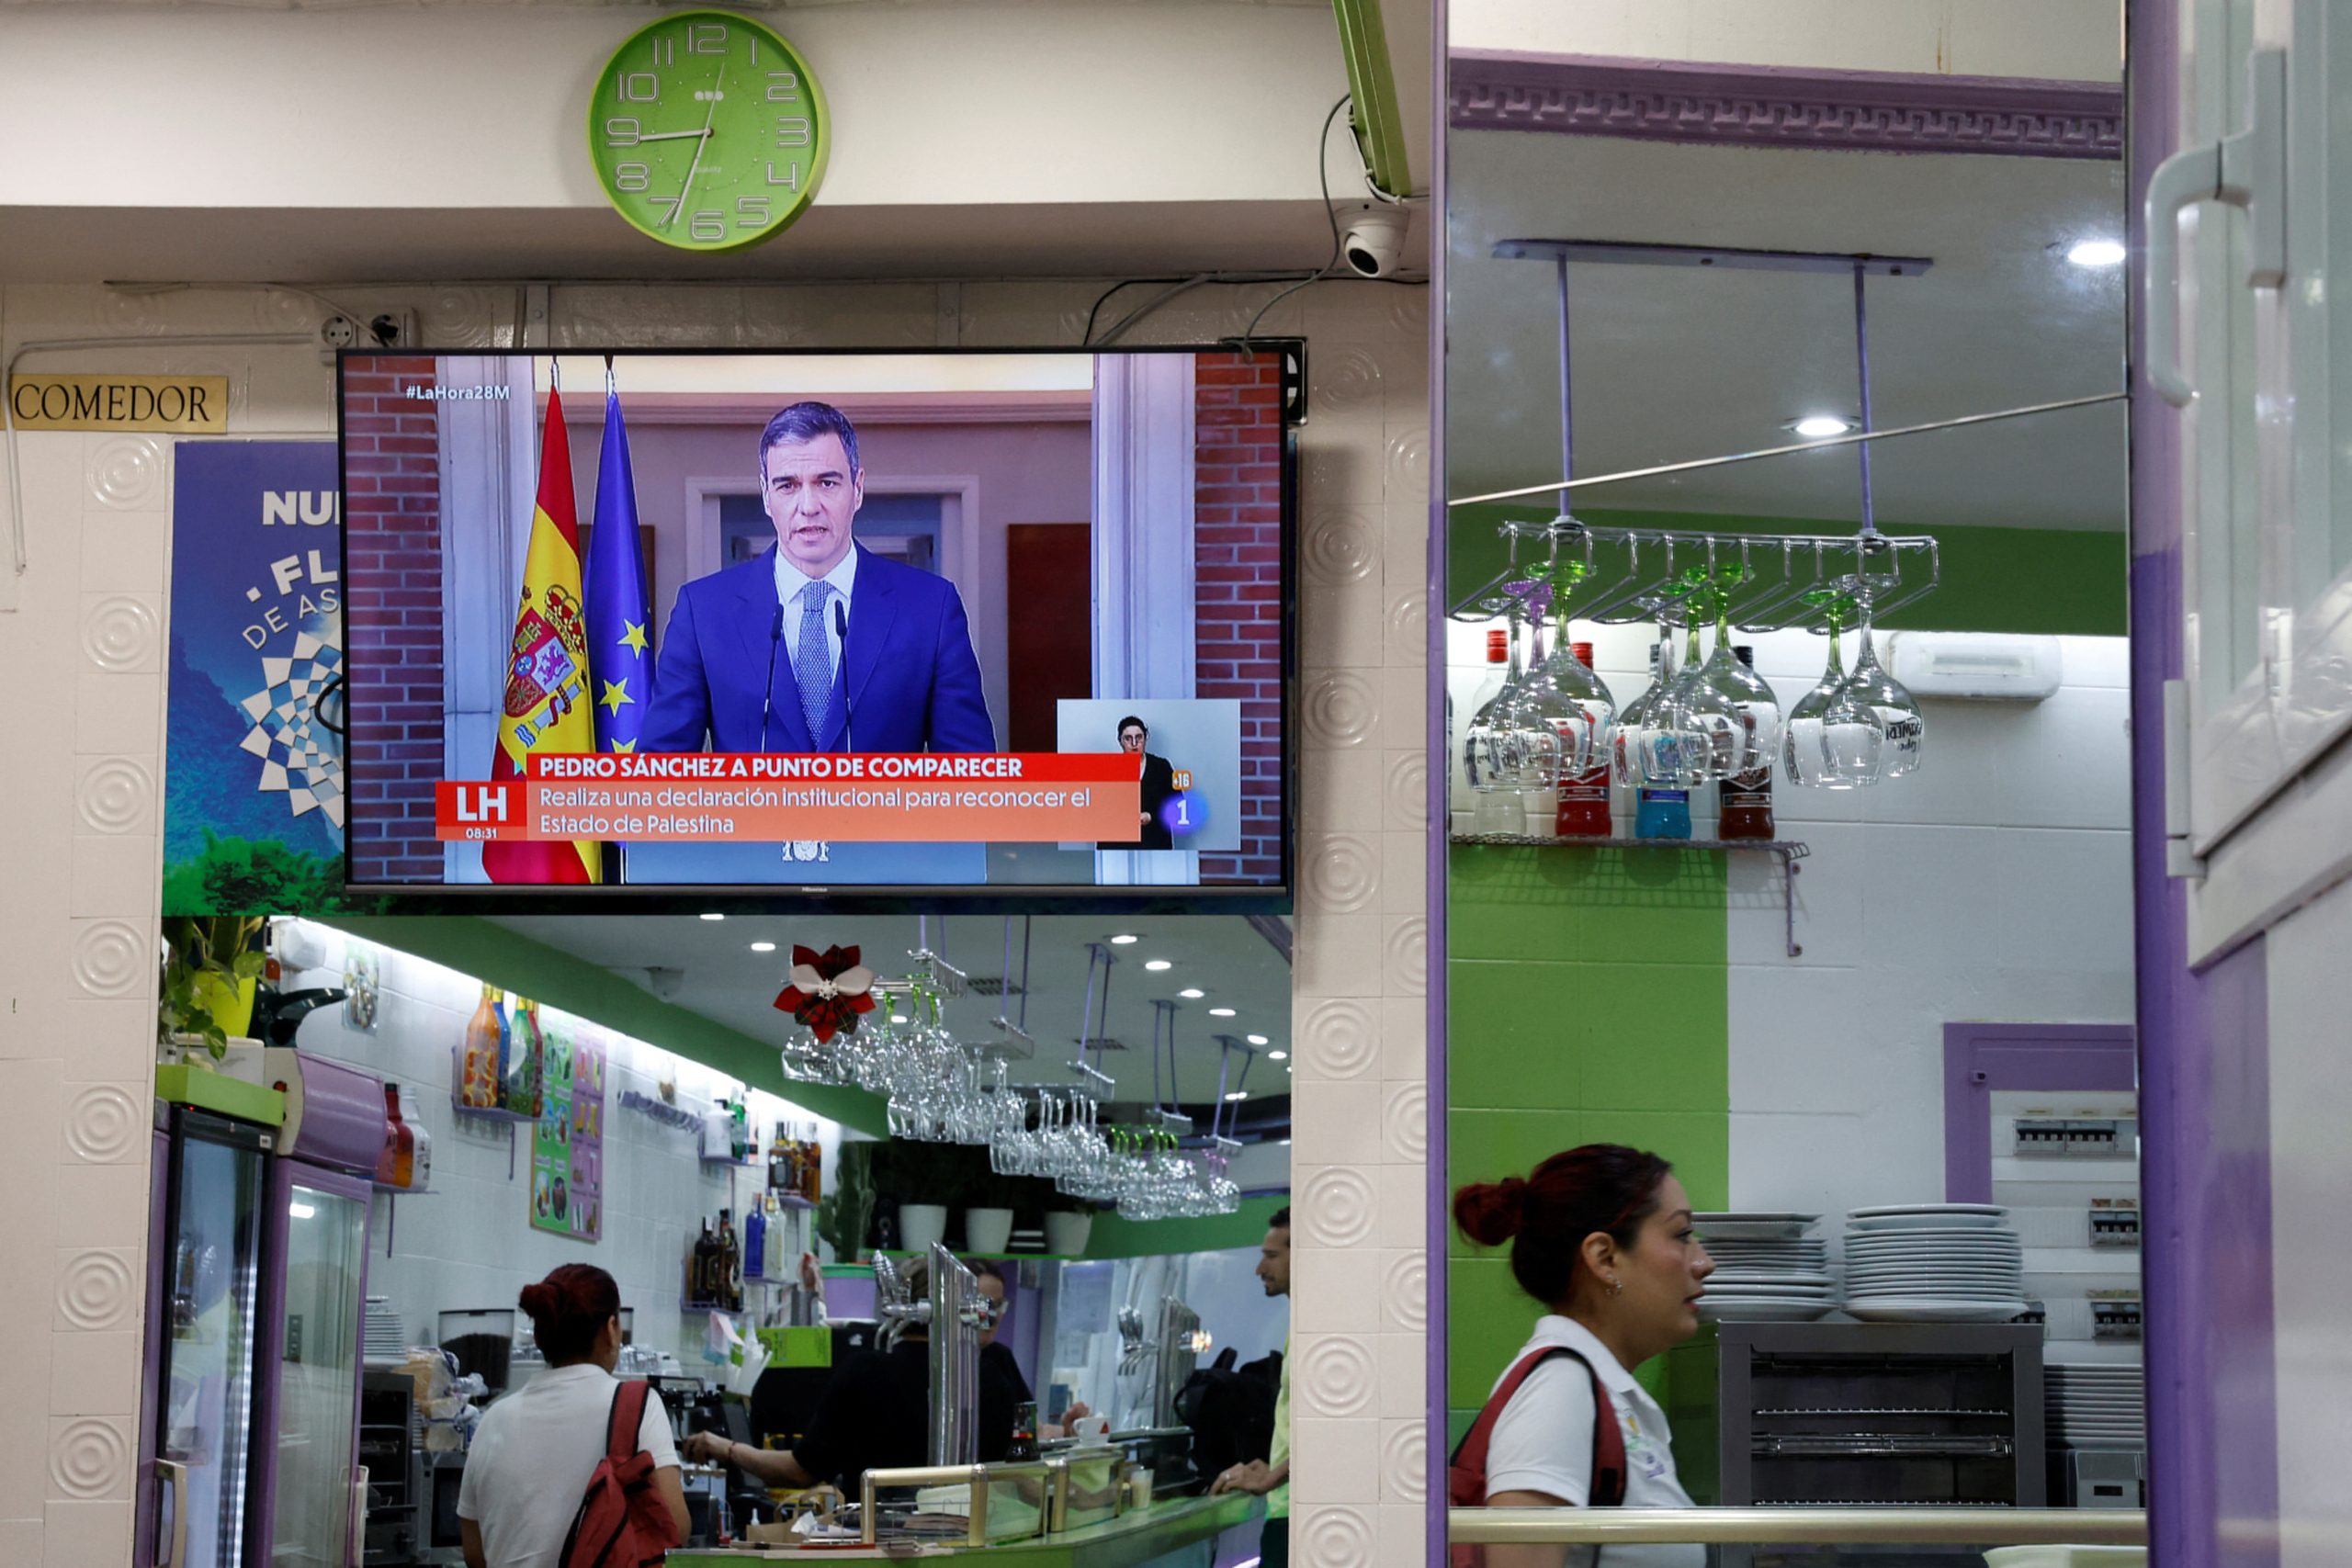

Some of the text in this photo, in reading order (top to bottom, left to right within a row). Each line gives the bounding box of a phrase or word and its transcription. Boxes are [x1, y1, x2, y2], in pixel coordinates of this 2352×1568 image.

[652, 37, 673, 67] 11
[686, 23, 729, 55] 12
[750, 37, 757, 67] 1
[616, 72, 659, 103] 10
[765, 71, 798, 102] 2
[605, 117, 640, 147] 9
[776, 116, 810, 147] 3
[616, 162, 650, 191] 8
[765, 161, 797, 191] 4
[647, 196, 682, 228] 7
[691, 209, 726, 242] 6
[736, 196, 772, 227] 5
[15, 383, 211, 423] COMEDOR
[406, 385, 510, 400] #LaHora28M
[262, 491, 339, 525] NU
[242, 606, 288, 650] DE
[539, 753, 1023, 777] PEDRO SÁNCHEZ A PUNTO DE COMPARECER
[457, 786, 507, 821] LH
[539, 787, 1091, 810] Realiza una declaración institucional para reconocer el
[1177, 799, 1190, 825] 1
[466, 828, 497, 840] 08:31
[539, 815, 734, 833] Estado de Palestina
